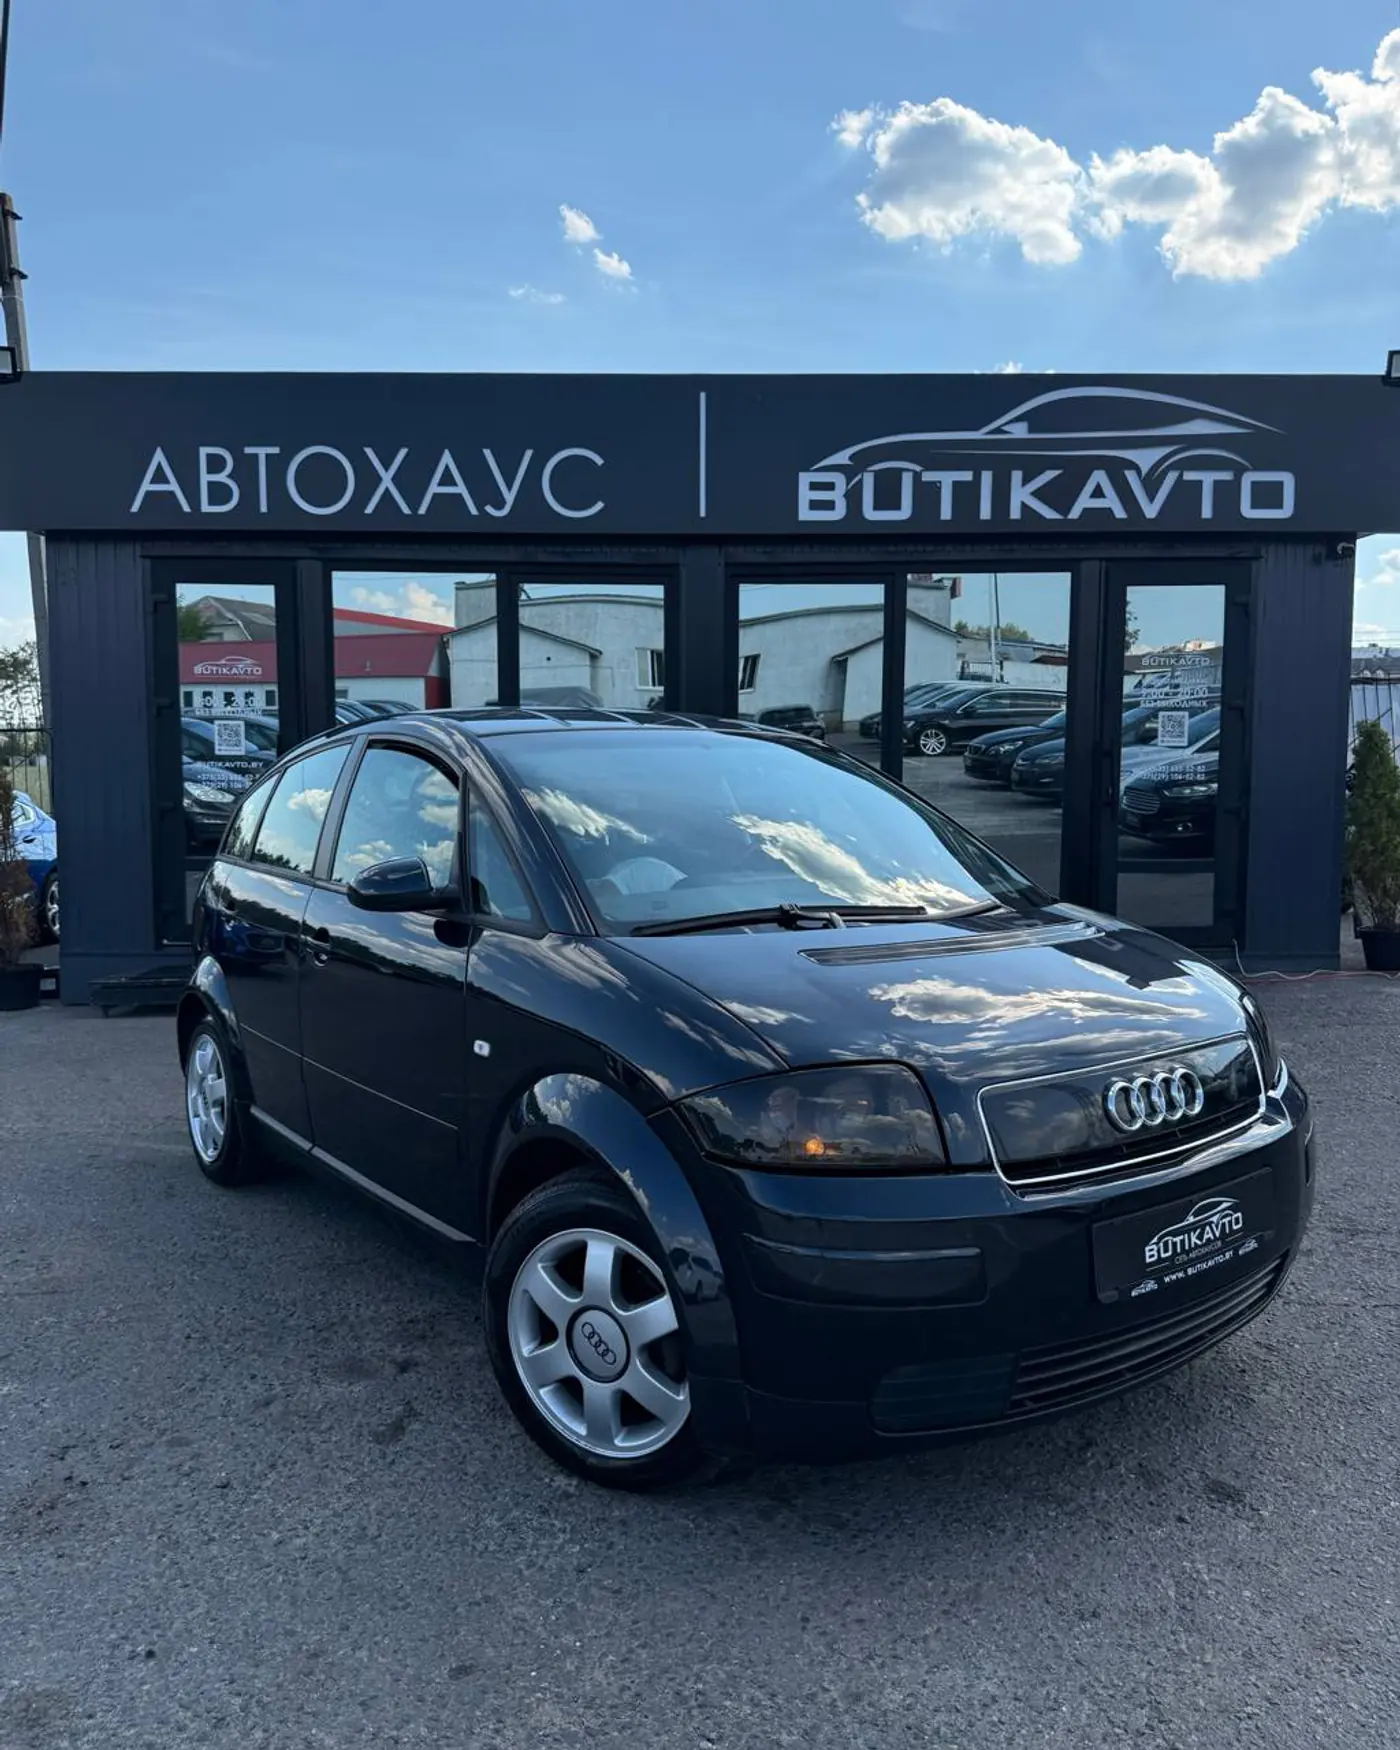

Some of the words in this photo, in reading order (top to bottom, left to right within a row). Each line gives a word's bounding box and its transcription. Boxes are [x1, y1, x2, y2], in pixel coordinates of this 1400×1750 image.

[130, 445, 606, 519] АВТОХАУС
[797, 469, 1296, 522] BUTIKAVTO
[194, 666, 263, 675] BUTIKAVTO
[1141, 657, 1210, 666] BUTIKAVTO
[1144, 1212, 1243, 1263] BUTIKAVTO
[1187, 1250, 1234, 1276] BUTIKAVTO.BY
